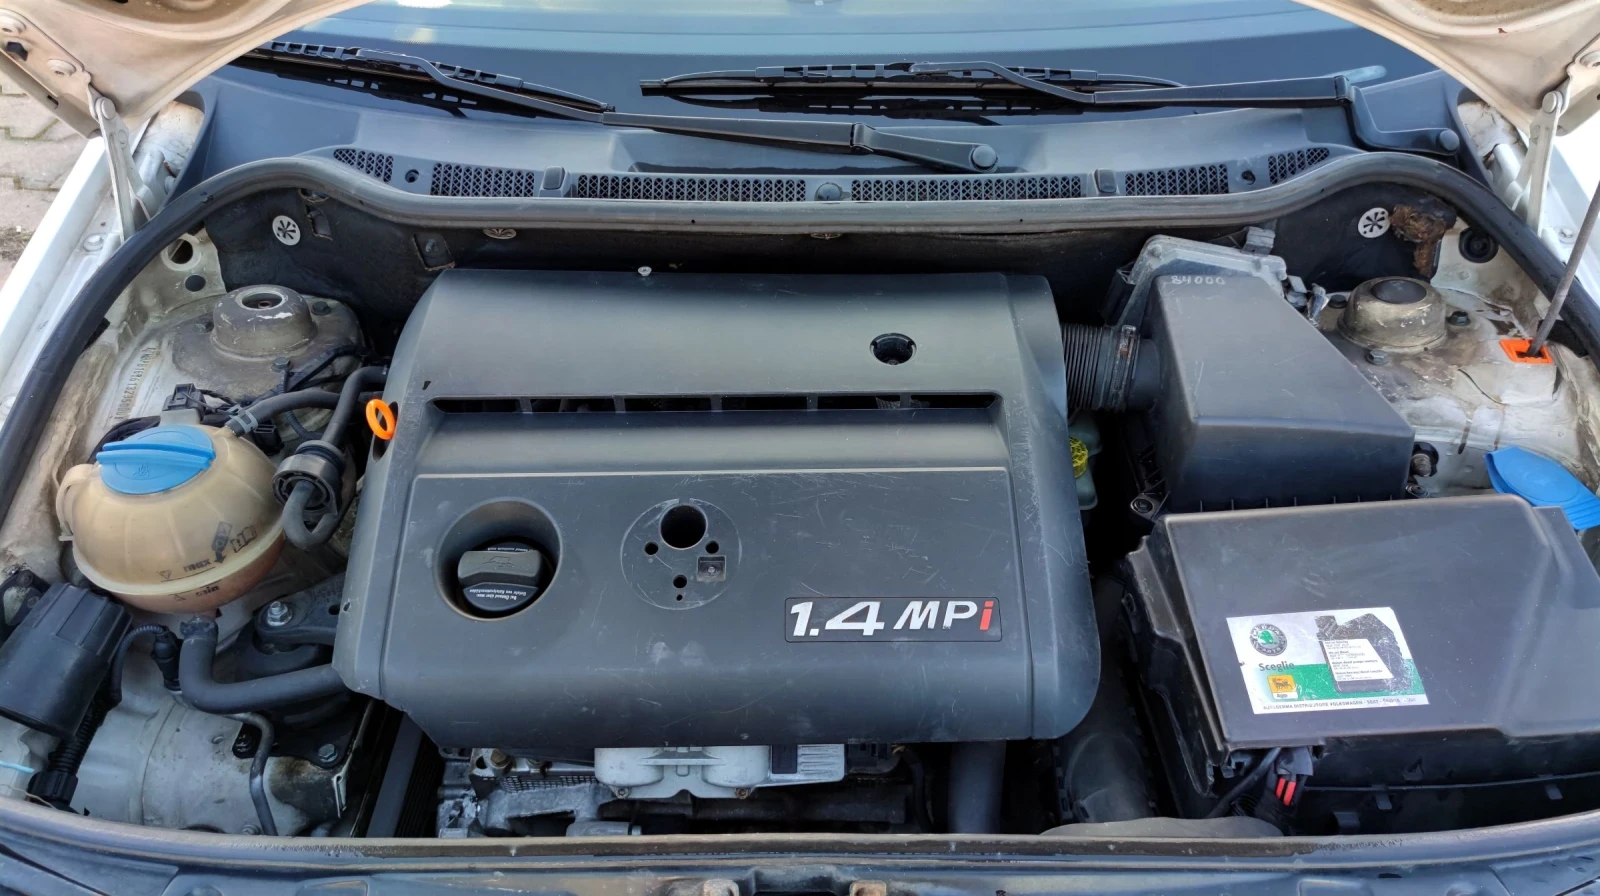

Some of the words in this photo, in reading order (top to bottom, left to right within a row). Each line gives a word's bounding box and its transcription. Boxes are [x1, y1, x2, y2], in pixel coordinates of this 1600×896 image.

[1171, 275, 1226, 285] 84000
[790, 600, 885, 637] 1.4
[893, 600, 994, 631] MPi
[1258, 660, 1295, 673] Sceglie
